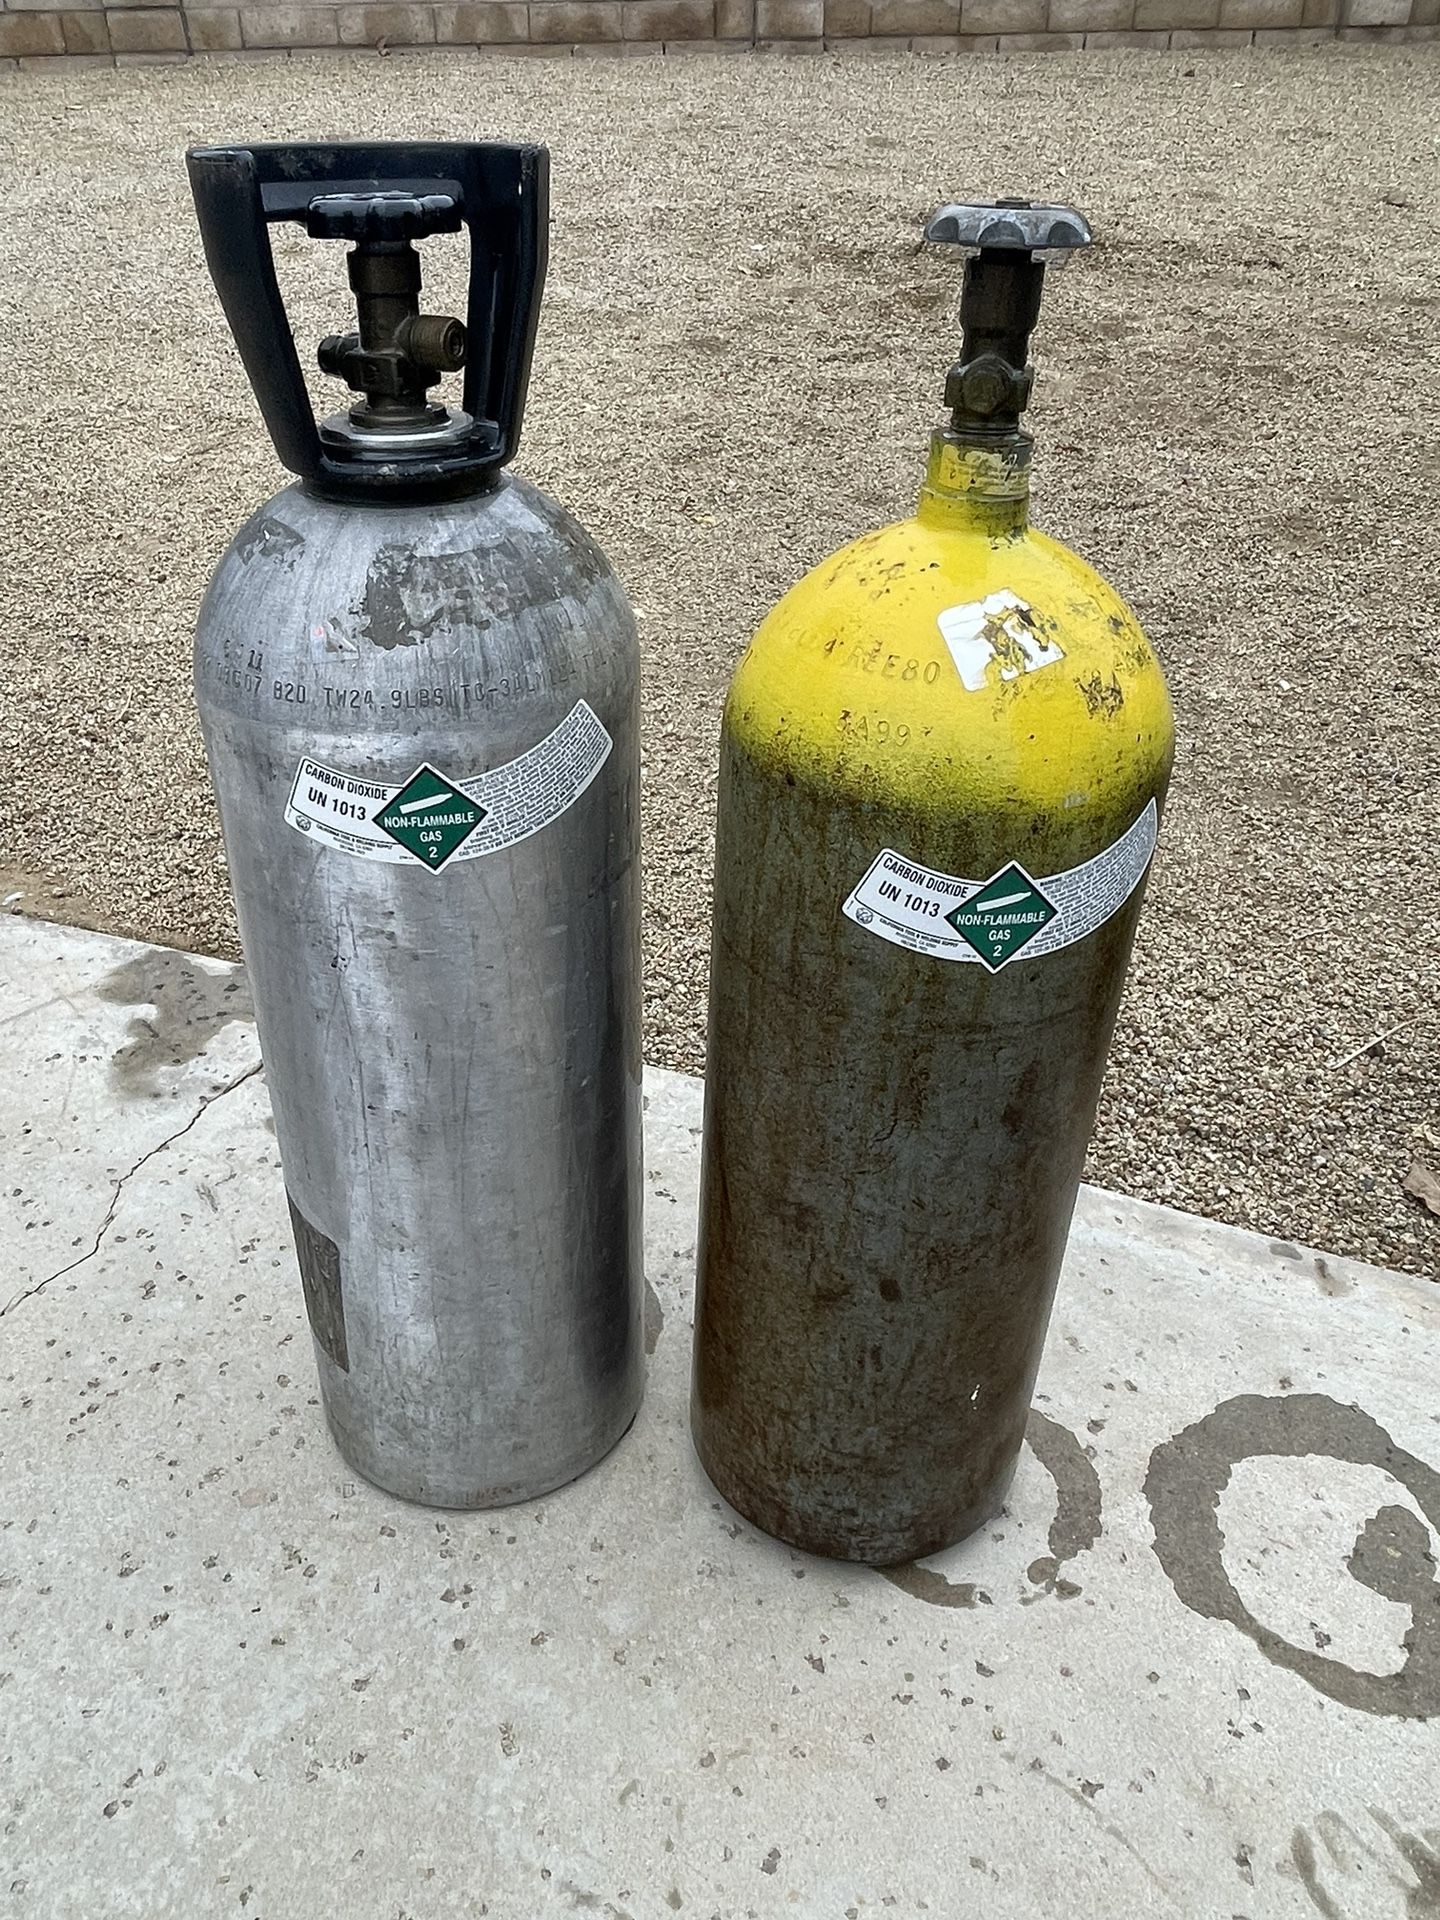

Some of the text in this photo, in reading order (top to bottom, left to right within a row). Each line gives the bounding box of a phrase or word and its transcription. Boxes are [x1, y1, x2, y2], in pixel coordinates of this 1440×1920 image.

[305, 763, 388, 801] CARBON DIOXIDE
[308, 786, 366, 820] UN 1013
[384, 811, 475, 829] NON-FLAMMABLE
[419, 830, 443, 843] GAS
[428, 846, 439, 858] 2
[883, 857, 969, 898] CARBON DIOXIDE
[878, 880, 941, 918] UN 1013
[956, 910, 1046, 926] NON-FLAMMABLE
[988, 929, 1011, 941] GAS
[992, 945, 1003, 957] 2
